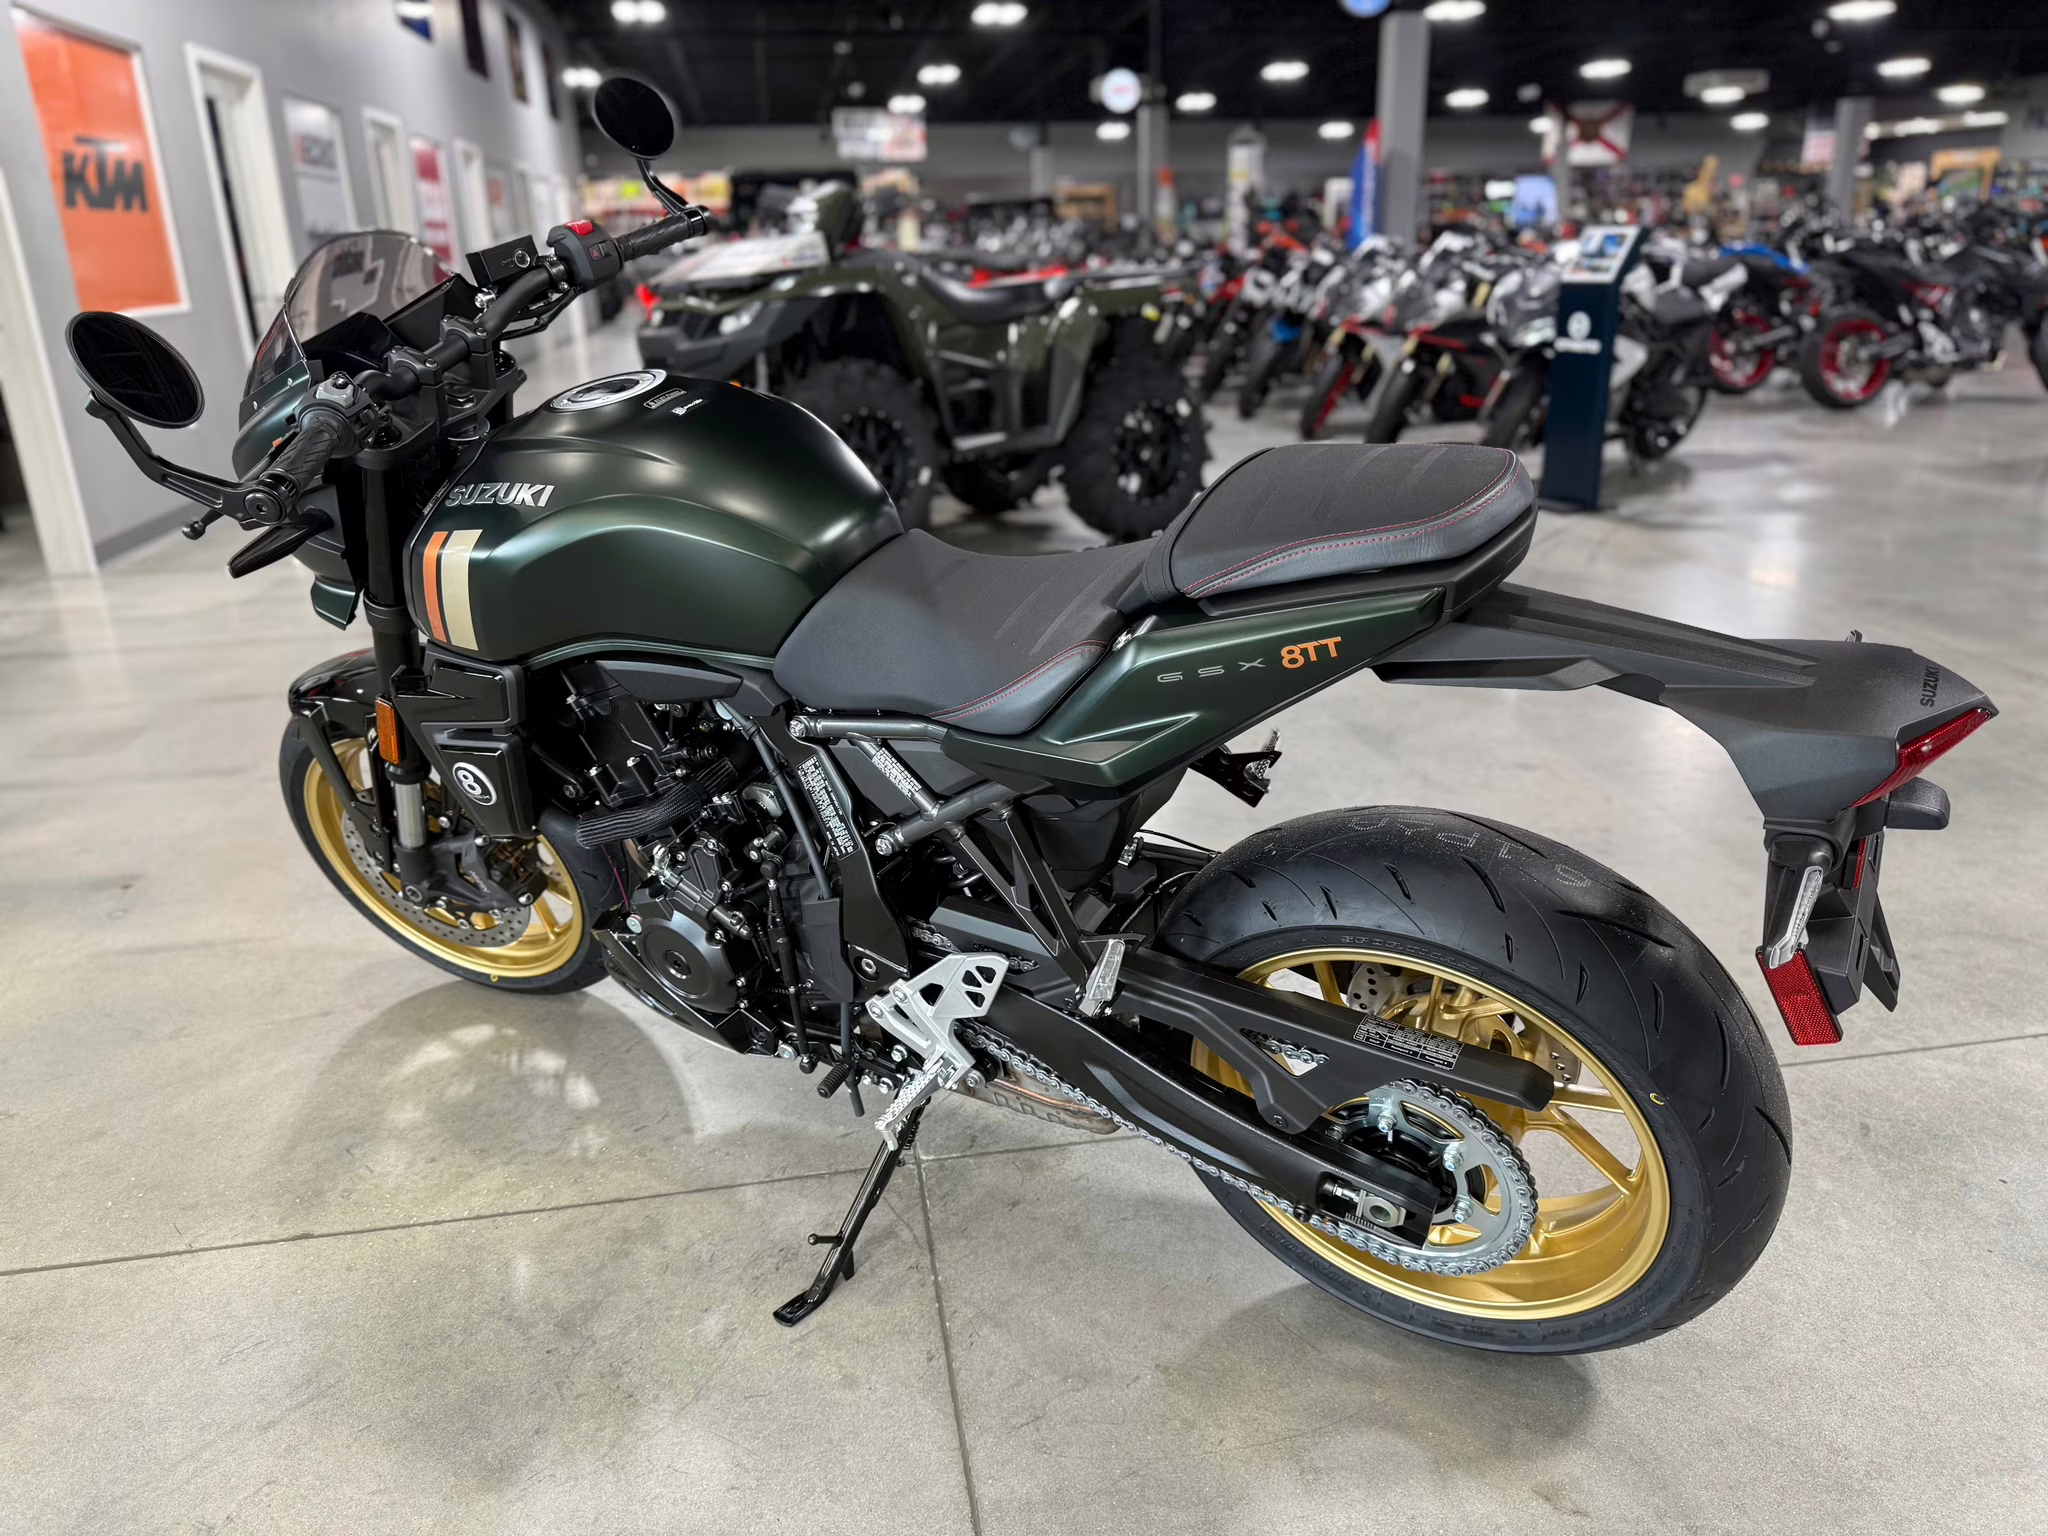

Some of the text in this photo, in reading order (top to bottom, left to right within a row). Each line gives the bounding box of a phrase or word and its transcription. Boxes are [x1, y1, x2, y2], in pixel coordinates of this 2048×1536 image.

[63, 136, 149, 213] KTM
[445, 482, 555, 508] SUZUKI
[1281, 636, 1343, 670] 8TT
[1920, 665, 1940, 708] SUZUKI
[457, 769, 483, 796] 8
